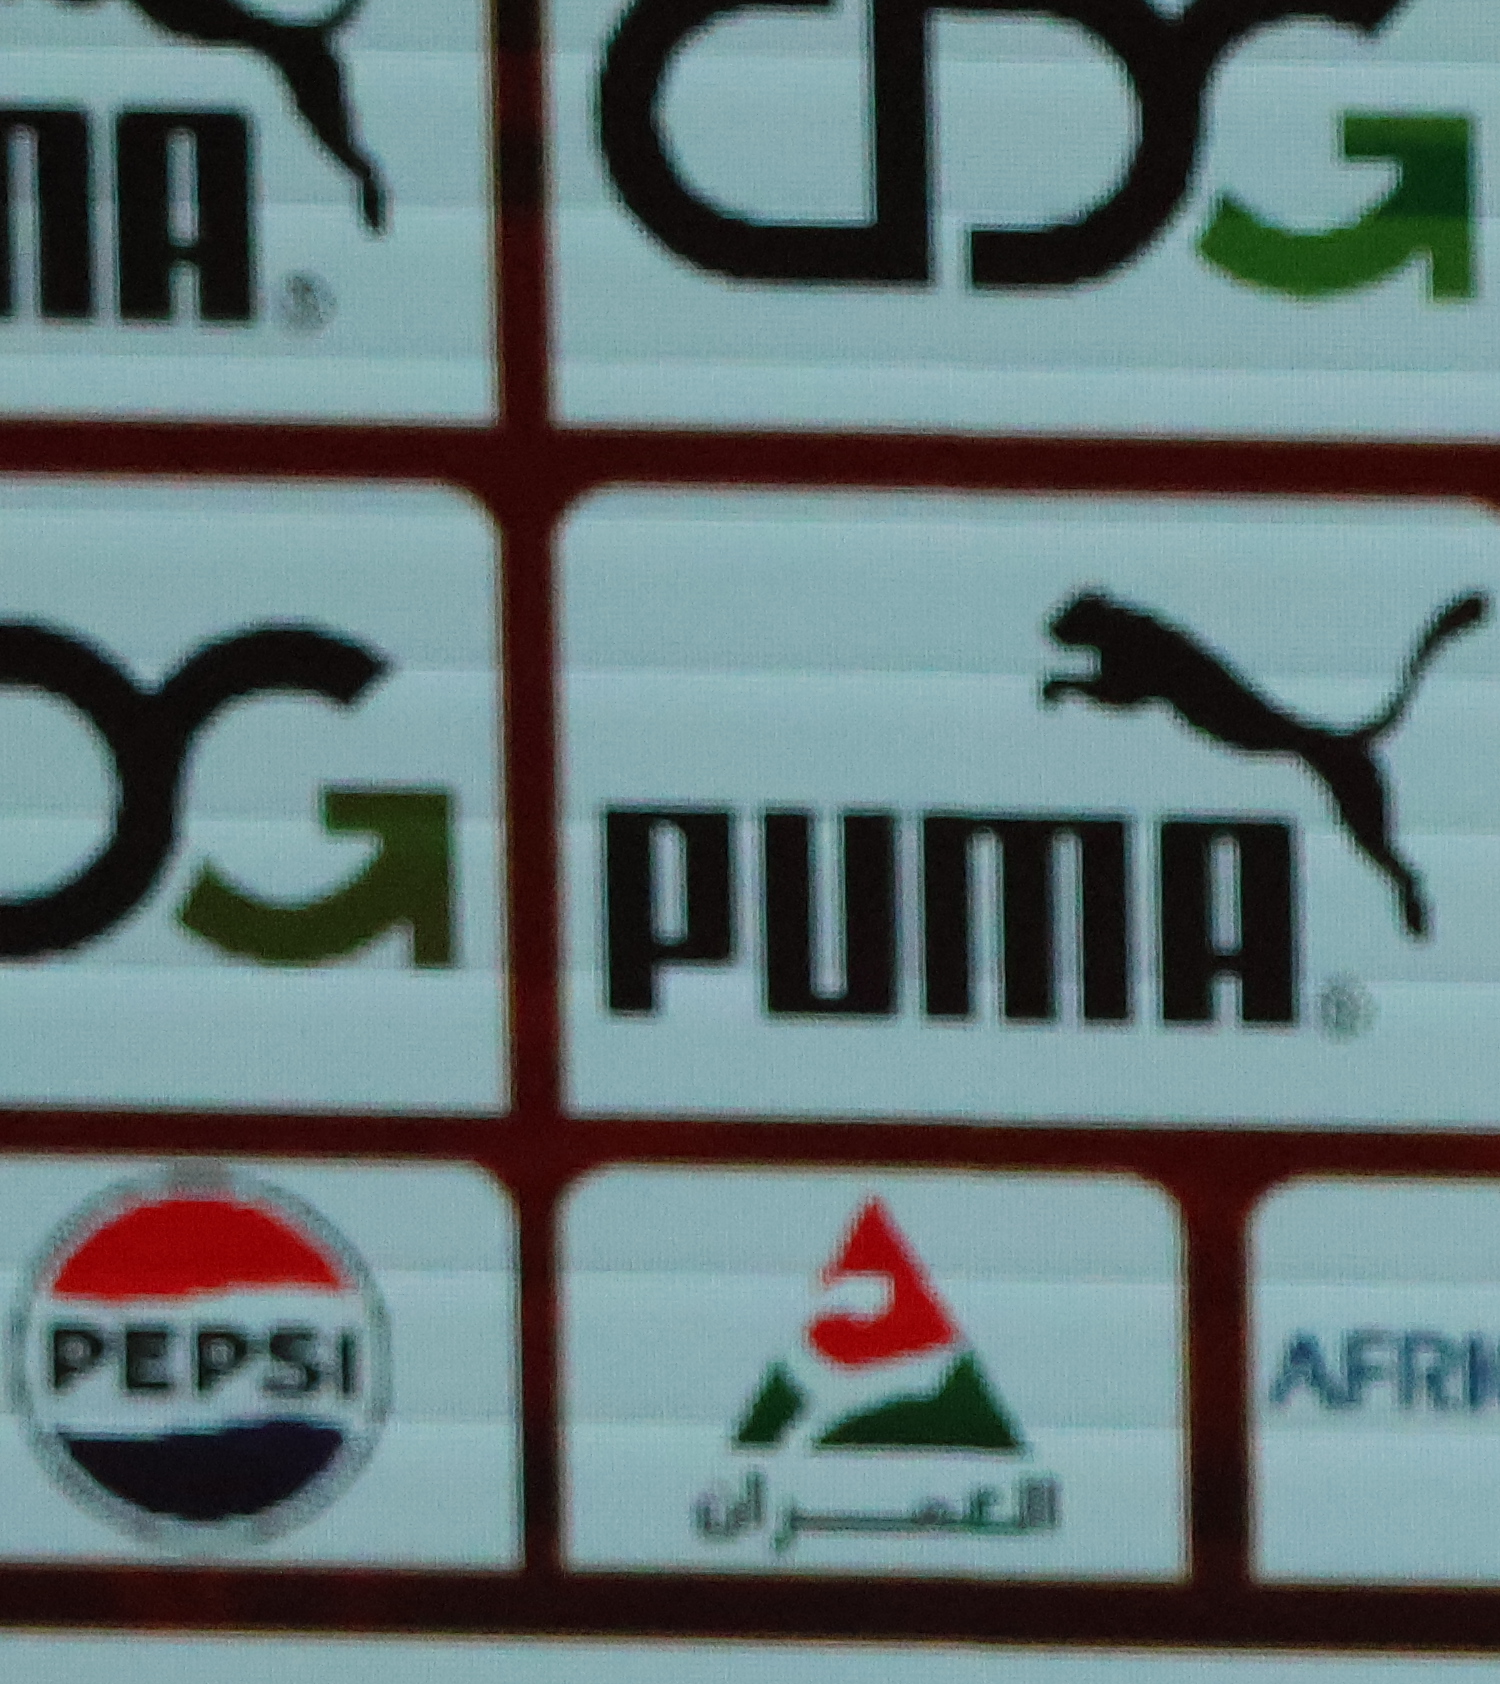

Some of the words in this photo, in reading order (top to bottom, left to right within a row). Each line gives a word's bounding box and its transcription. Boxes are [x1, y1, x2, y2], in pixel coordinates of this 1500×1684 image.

[592, 0, 1478, 300] CDG
[604, 805, 1302, 1026] PUMA
[46, 1318, 360, 1398] PEPSI
